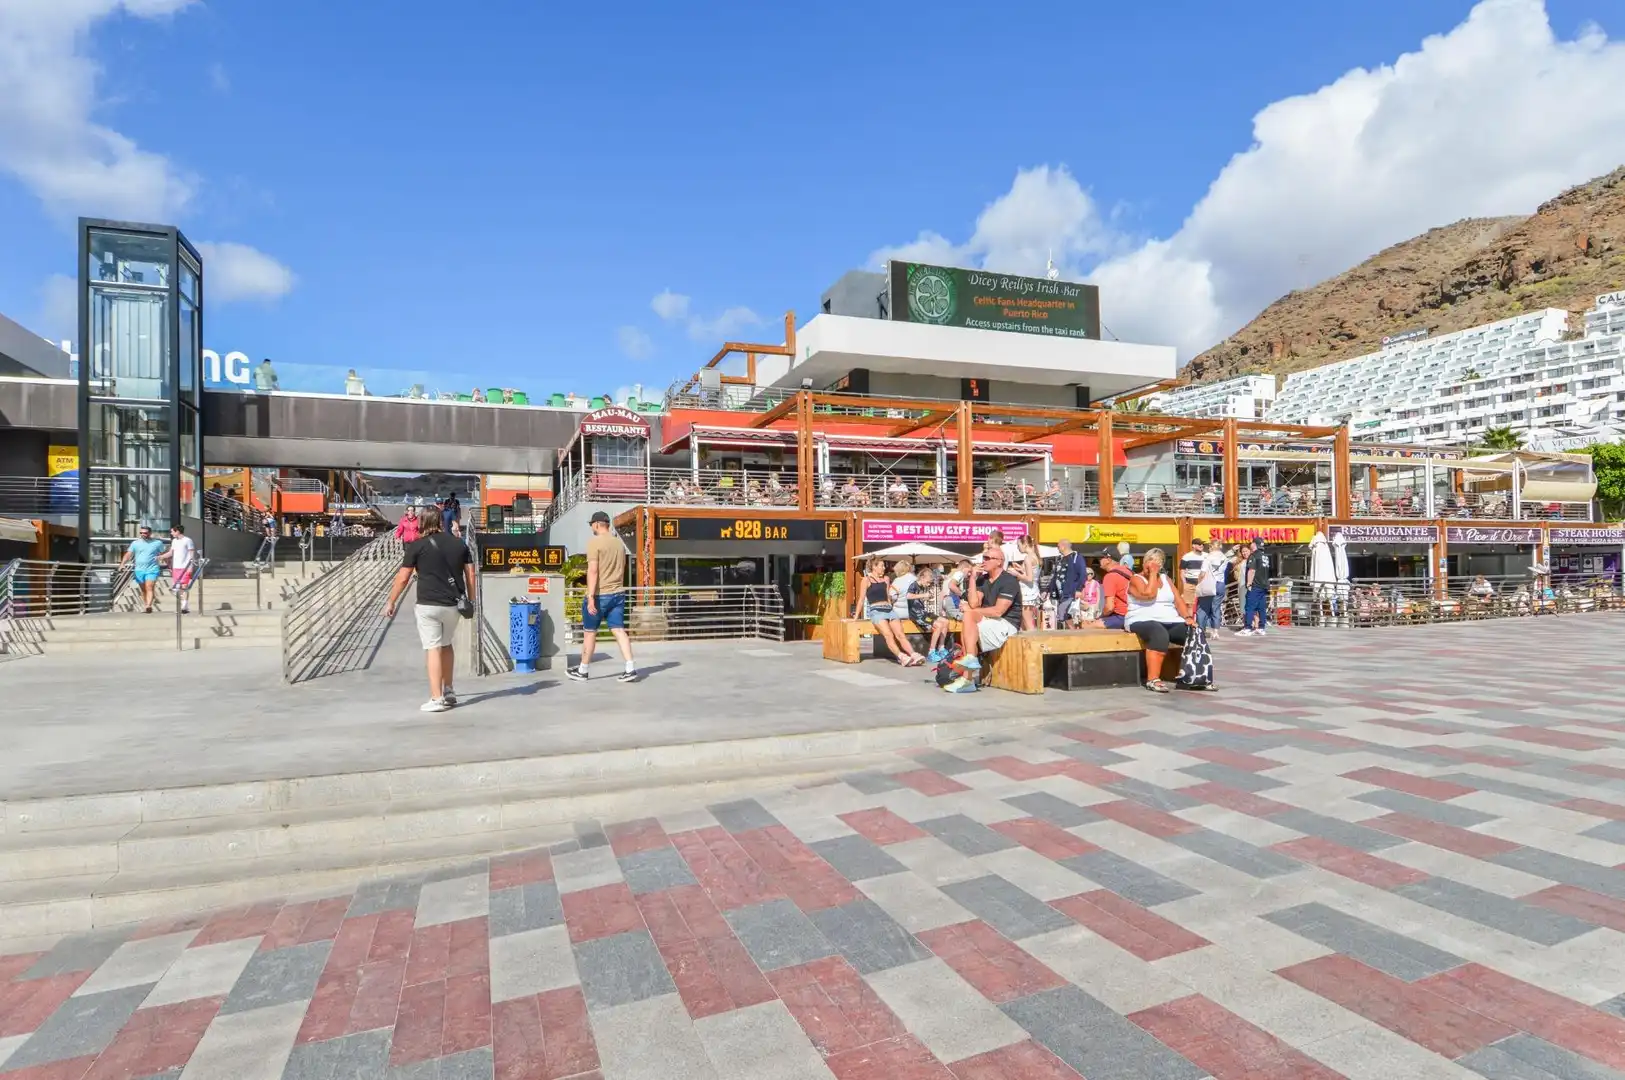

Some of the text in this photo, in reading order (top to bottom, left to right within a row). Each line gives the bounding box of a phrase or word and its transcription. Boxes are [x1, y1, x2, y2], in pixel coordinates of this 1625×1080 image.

[968, 273, 1081, 297] Dicey Reillys Irish Bar
[973, 296, 1075, 309] Celtic Fans Headquarter in
[1003, 308, 1049, 319] Puerto Rico
[965, 317, 1086, 337] Access upstairs from the taxi rank
[591, 408, 640, 423] MAU-MAU
[584, 424, 647, 435] RESTAURANTE
[1552, 436, 1598, 447] VICTORIA
[735, 520, 787, 539] 928 BAR
[895, 525, 922, 534] BEST
[923, 525, 945, 535] BUY
[946, 526, 971, 535] GIFT
[1209, 527, 1299, 543] SUPERMARKET
[1341, 526, 1428, 536] RESTAURANTE
[1466, 528, 1488, 541] Pico
[1501, 529, 1525, 542] Oro
[1558, 529, 1623, 538] STEAK HOUSE
[531, 549, 539, 557] &
